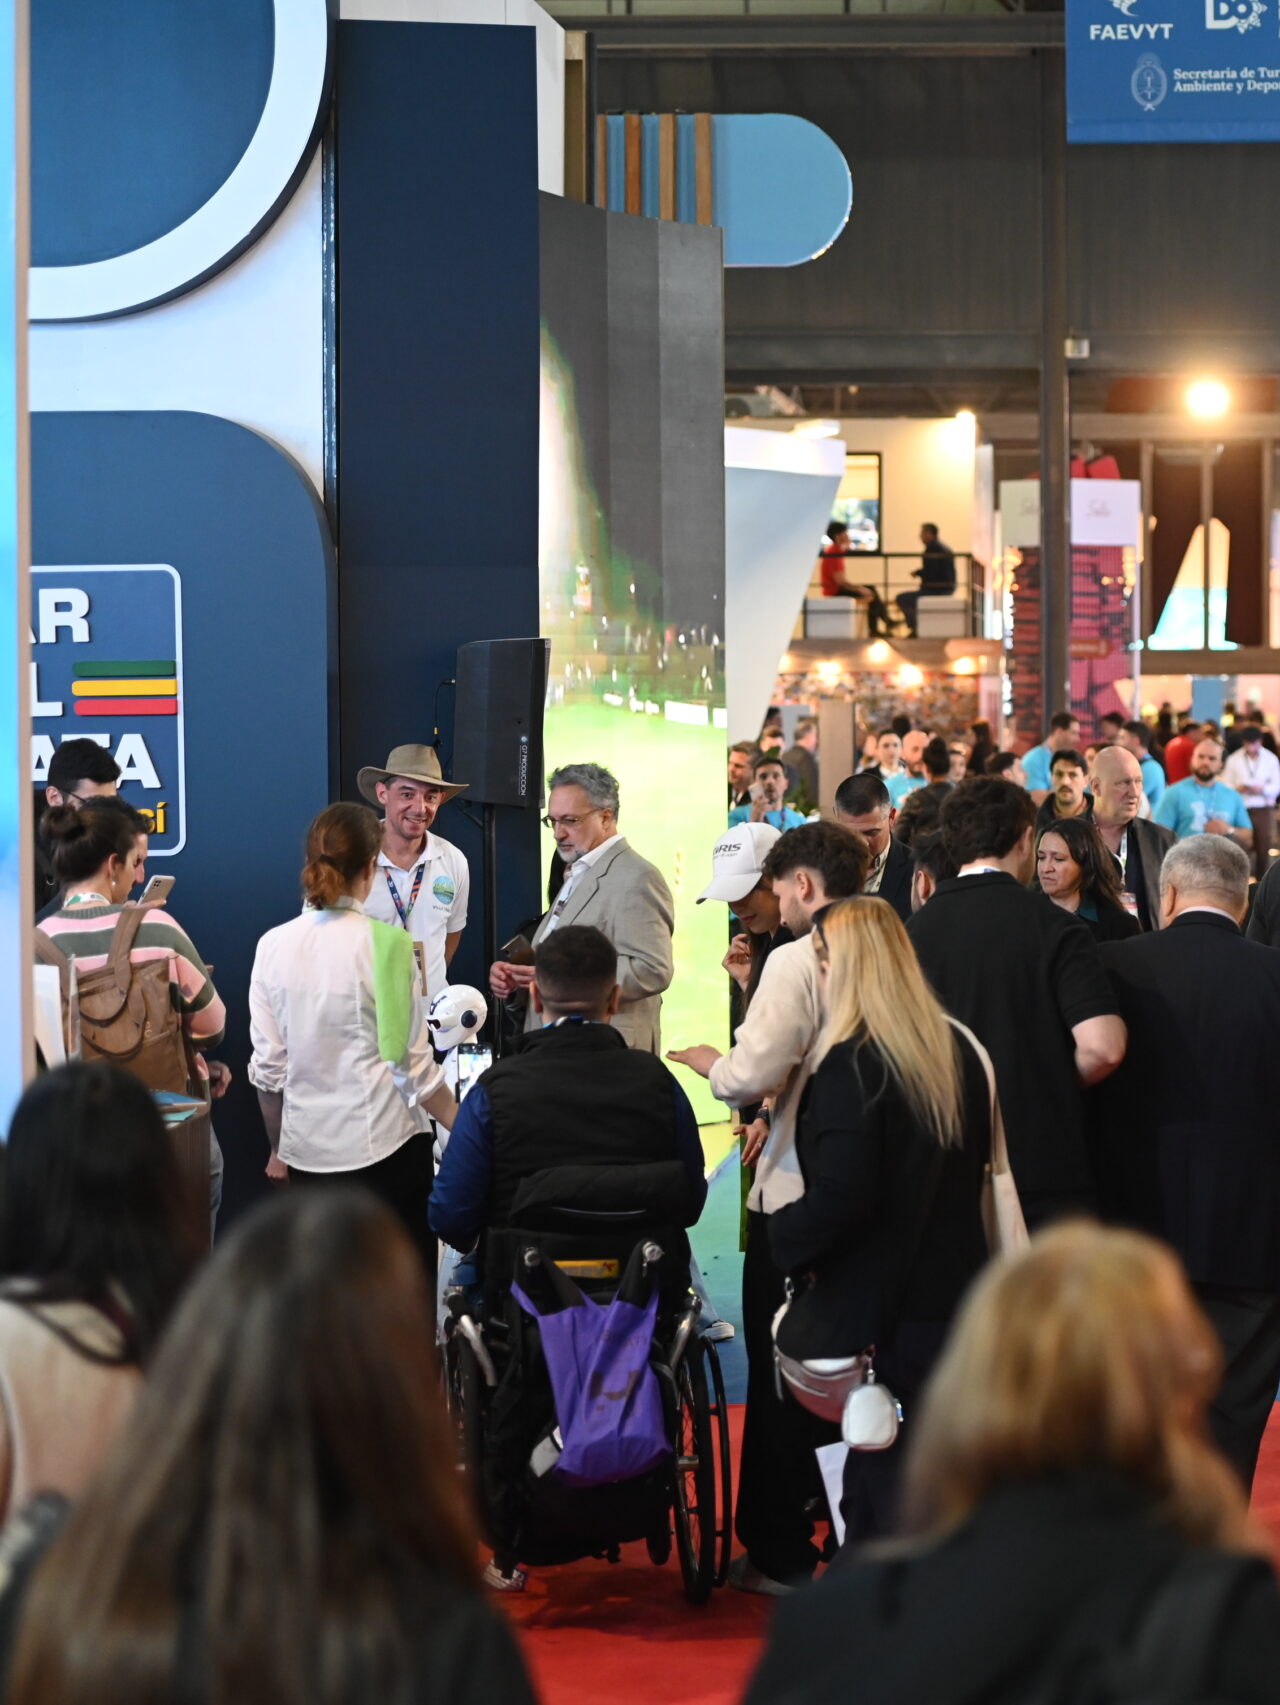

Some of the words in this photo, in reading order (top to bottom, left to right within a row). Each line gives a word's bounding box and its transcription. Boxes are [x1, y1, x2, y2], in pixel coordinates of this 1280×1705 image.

[1089, 24, 1174, 40] FAEVYT
[1239, 67, 1256, 79] de
[1173, 80, 1233, 92] Ambiente
[1236, 82, 1244, 94] y
[30, 587, 91, 644] R
